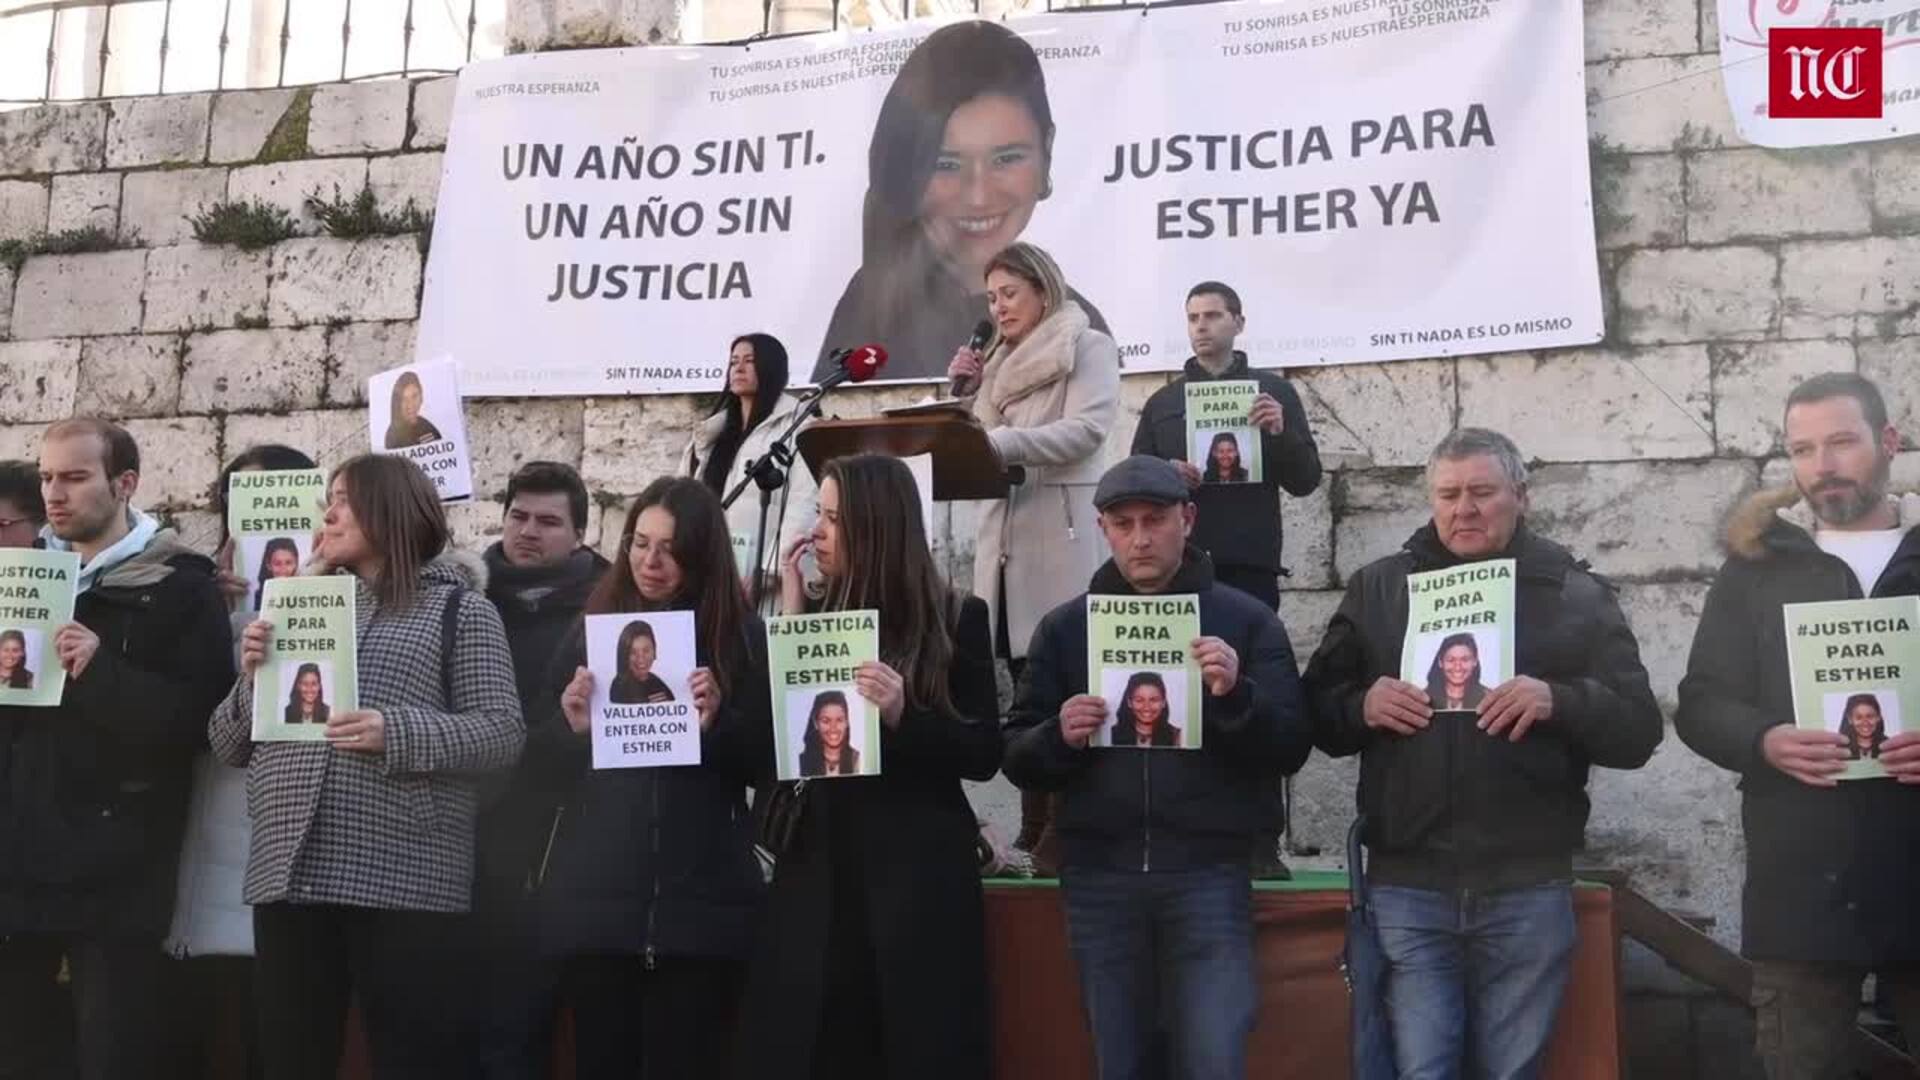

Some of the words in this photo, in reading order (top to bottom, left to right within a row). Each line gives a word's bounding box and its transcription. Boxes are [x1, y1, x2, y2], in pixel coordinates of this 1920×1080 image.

[1389, 4, 1408, 17] TU
[1224, 22, 1242, 33] TU
[1246, 12, 1308, 32] SONRISA
[1312, 8, 1329, 21] ES
[1034, 45, 1101, 59] PERANZA
[1222, 45, 1240, 56] TU
[1244, 37, 1307, 55] SONRISA
[1311, 34, 1328, 47] ES
[710, 66, 728, 78] TU
[731, 59, 783, 75] SONRISA
[786, 57, 801, 69] ES
[803, 46, 858, 66] NUESTRA
[528, 81, 600, 95] ESPERANZA
[709, 91, 726, 102] TU
[729, 84, 780, 100] SONRISA
[784, 81, 799, 92] ES
[801, 71, 855, 89] NUESTRA
[858, 63, 898, 78] ESPER
[1104, 125, 1332, 183] JUSTICIA
[1351, 103, 1496, 158] PARA
[503, 143, 564, 181] UN
[574, 136, 681, 180] AÑO
[692, 136, 765, 176] SIN
[776, 130, 826, 170] TI.
[525, 202, 588, 240] UN
[600, 196, 704, 239] AÑO
[717, 196, 792, 235] SIN
[1156, 187, 1358, 240] ESTHER
[1369, 181, 1441, 226] YA
[547, 261, 752, 302] JUSTICIA
[1371, 334, 1396, 347] SIN
[1400, 332, 1413, 344] TI
[1417, 328, 1464, 343] NADA
[1467, 326, 1486, 338] ES
[1490, 323, 1511, 337] LO
[1513, 316, 1572, 335] MISMO
[606, 367, 626, 380] SIN
[629, 367, 640, 379] TI
[643, 367, 683, 379] NADA
[686, 367, 702, 379] ES
[705, 367, 723, 379] LO
[1203, 401, 1239, 412] PARA
[1195, 416, 1248, 429] ESTHER
[432, 458, 457, 471] CON
[232, 473, 324, 489] #JUSTICIA
[252, 495, 300, 510] PARA
[241, 517, 312, 532] ESTHER
[0, 565, 67, 581] USTICIA
[1411, 565, 1511, 594] #JUSTICIA
[267, 594, 346, 609] #JUSTICIA
[1090, 600, 1197, 616] #JUSTICIA
[1434, 591, 1484, 612] PARA
[287, 617, 327, 630] PARA
[769, 616, 875, 636] #JUSTICIA
[1420, 610, 1497, 633] ESTHER
[1797, 618, 1910, 636] #JUSTICIA
[1115, 625, 1171, 640] PARA
[276, 638, 336, 651] ESTHER
[797, 642, 850, 660] PARA
[1826, 643, 1885, 659] PARA
[1102, 649, 1184, 664] ESTHER
[1814, 665, 1901, 683] ESTHER
[603, 704, 688, 719] VALLADOLID
[604, 723, 657, 737] ENTERA
[659, 722, 688, 735] CON
[622, 740, 672, 754] ESTHER
